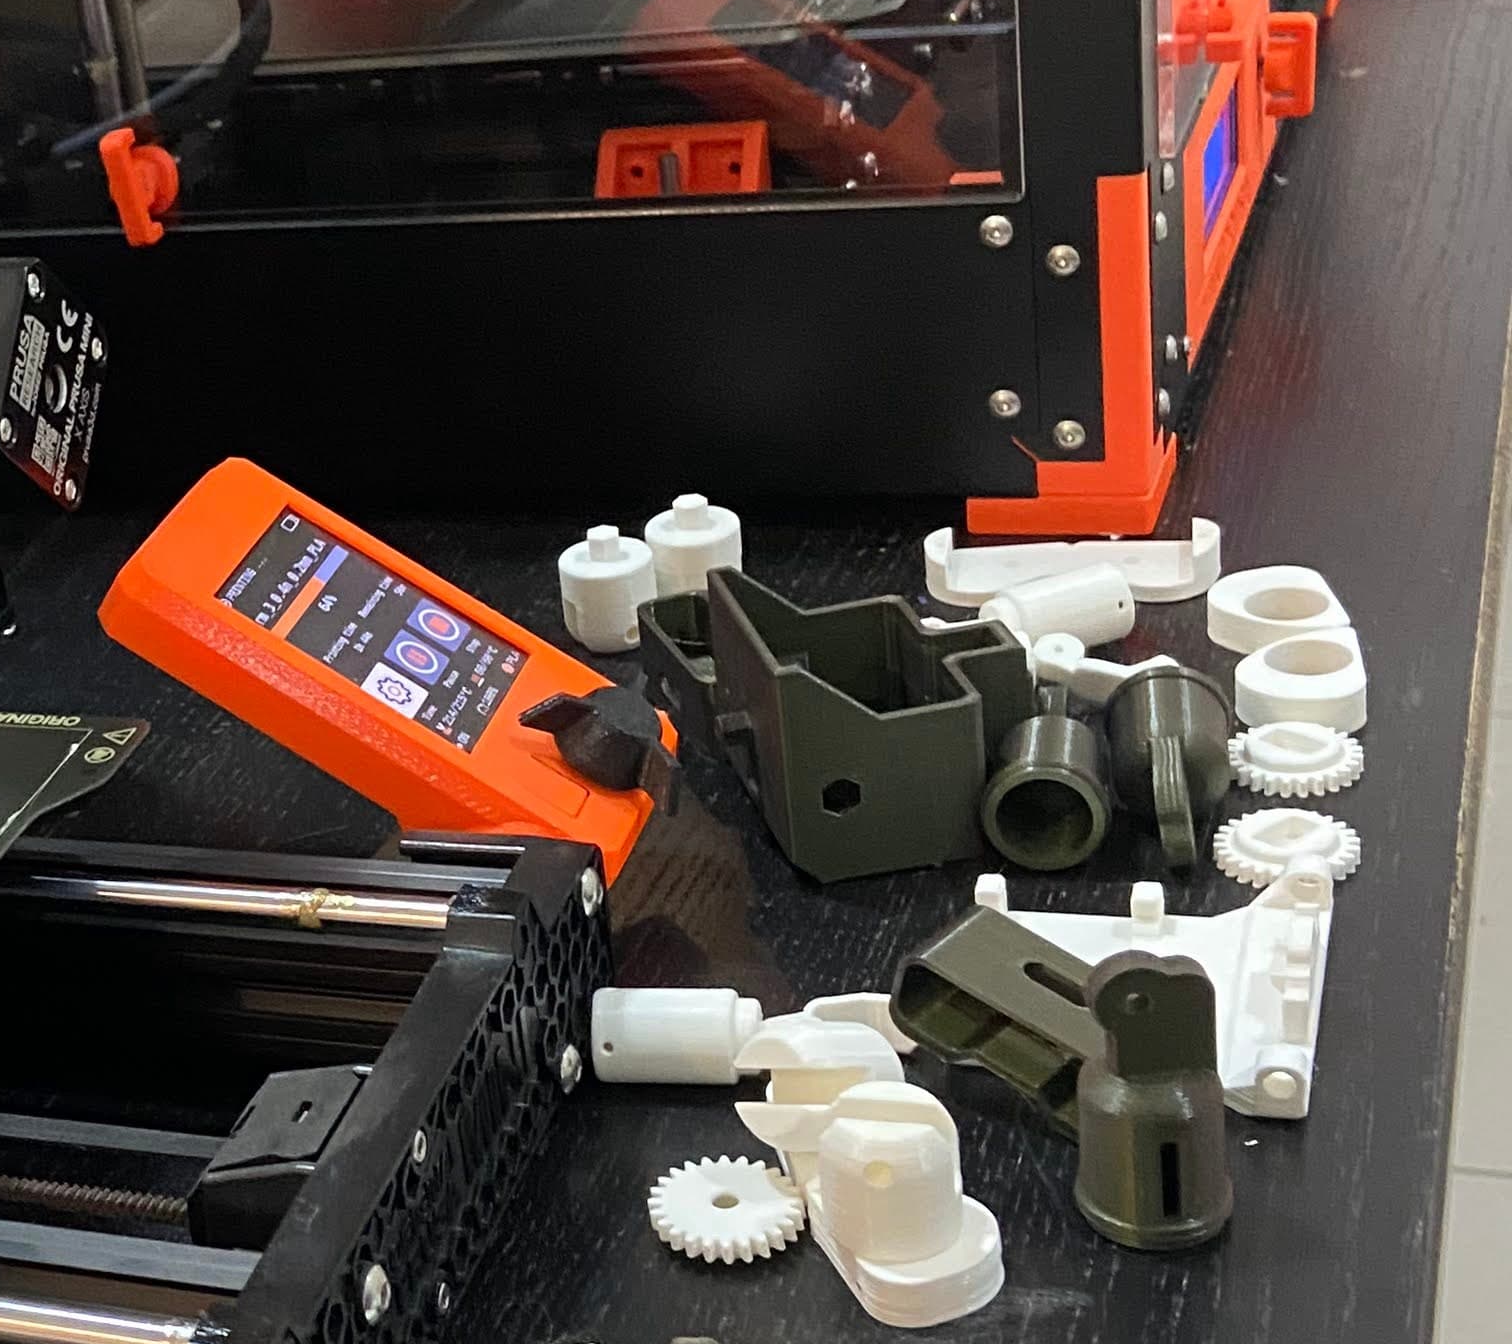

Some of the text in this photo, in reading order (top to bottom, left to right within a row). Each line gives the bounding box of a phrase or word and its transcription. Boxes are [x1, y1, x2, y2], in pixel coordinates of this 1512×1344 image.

[9, 315, 35, 403] PRUSA
[53, 312, 93, 496] ORIGINAL PRUSA MINI
[225, 567, 257, 601] PRINTING
